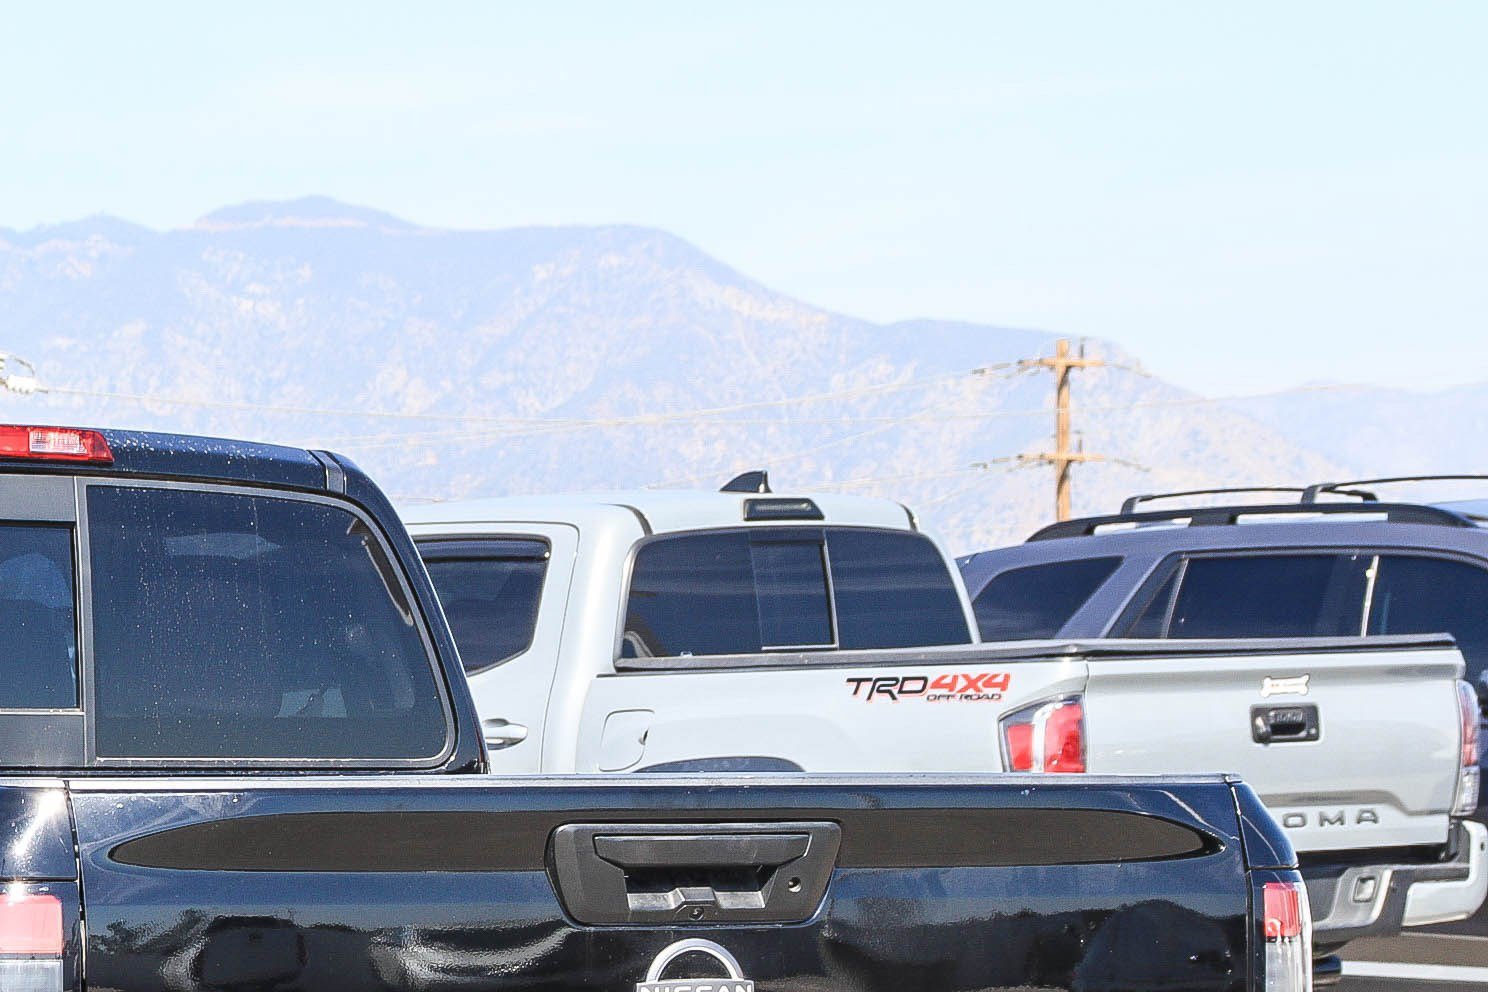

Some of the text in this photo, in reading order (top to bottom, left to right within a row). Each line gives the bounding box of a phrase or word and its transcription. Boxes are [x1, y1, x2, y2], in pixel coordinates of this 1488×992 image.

[846, 676, 929, 701] TRD
[926, 693, 1002, 702] OFF ROAD
[1282, 808, 1380, 829] OMA
